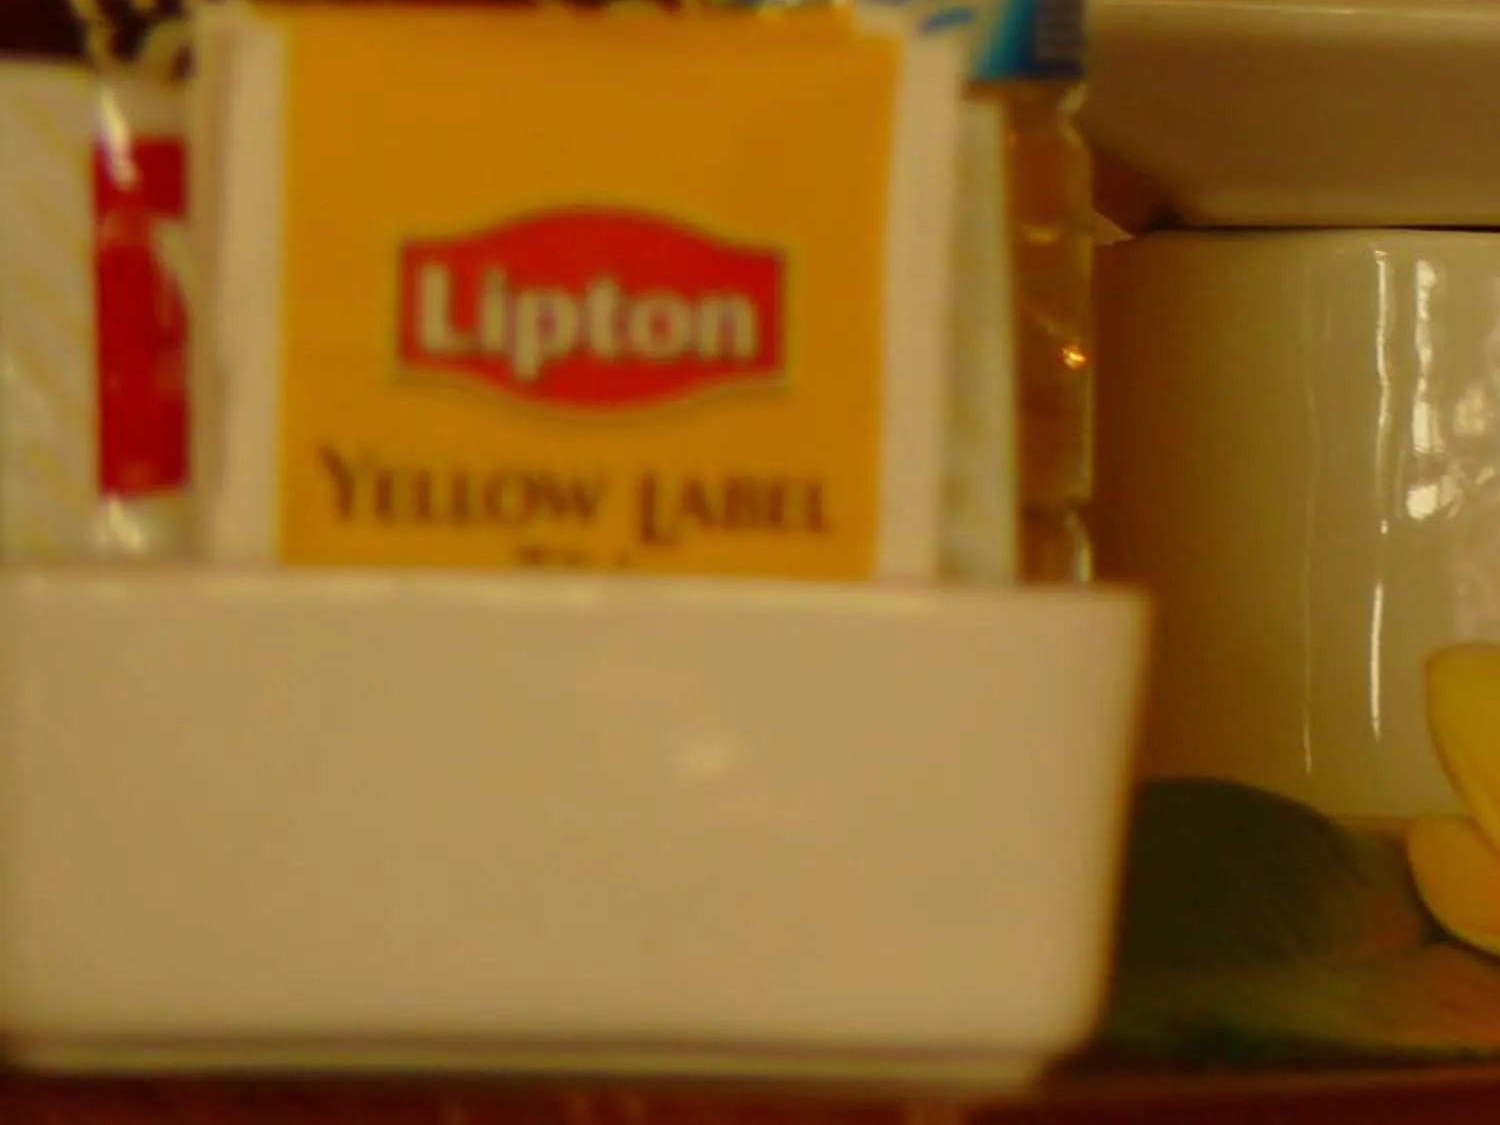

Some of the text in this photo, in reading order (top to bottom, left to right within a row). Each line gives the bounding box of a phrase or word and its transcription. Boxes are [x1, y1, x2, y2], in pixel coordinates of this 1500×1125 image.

[414, 261, 758, 381] Lipton
[317, 443, 830, 547] YELLOW LABEL
